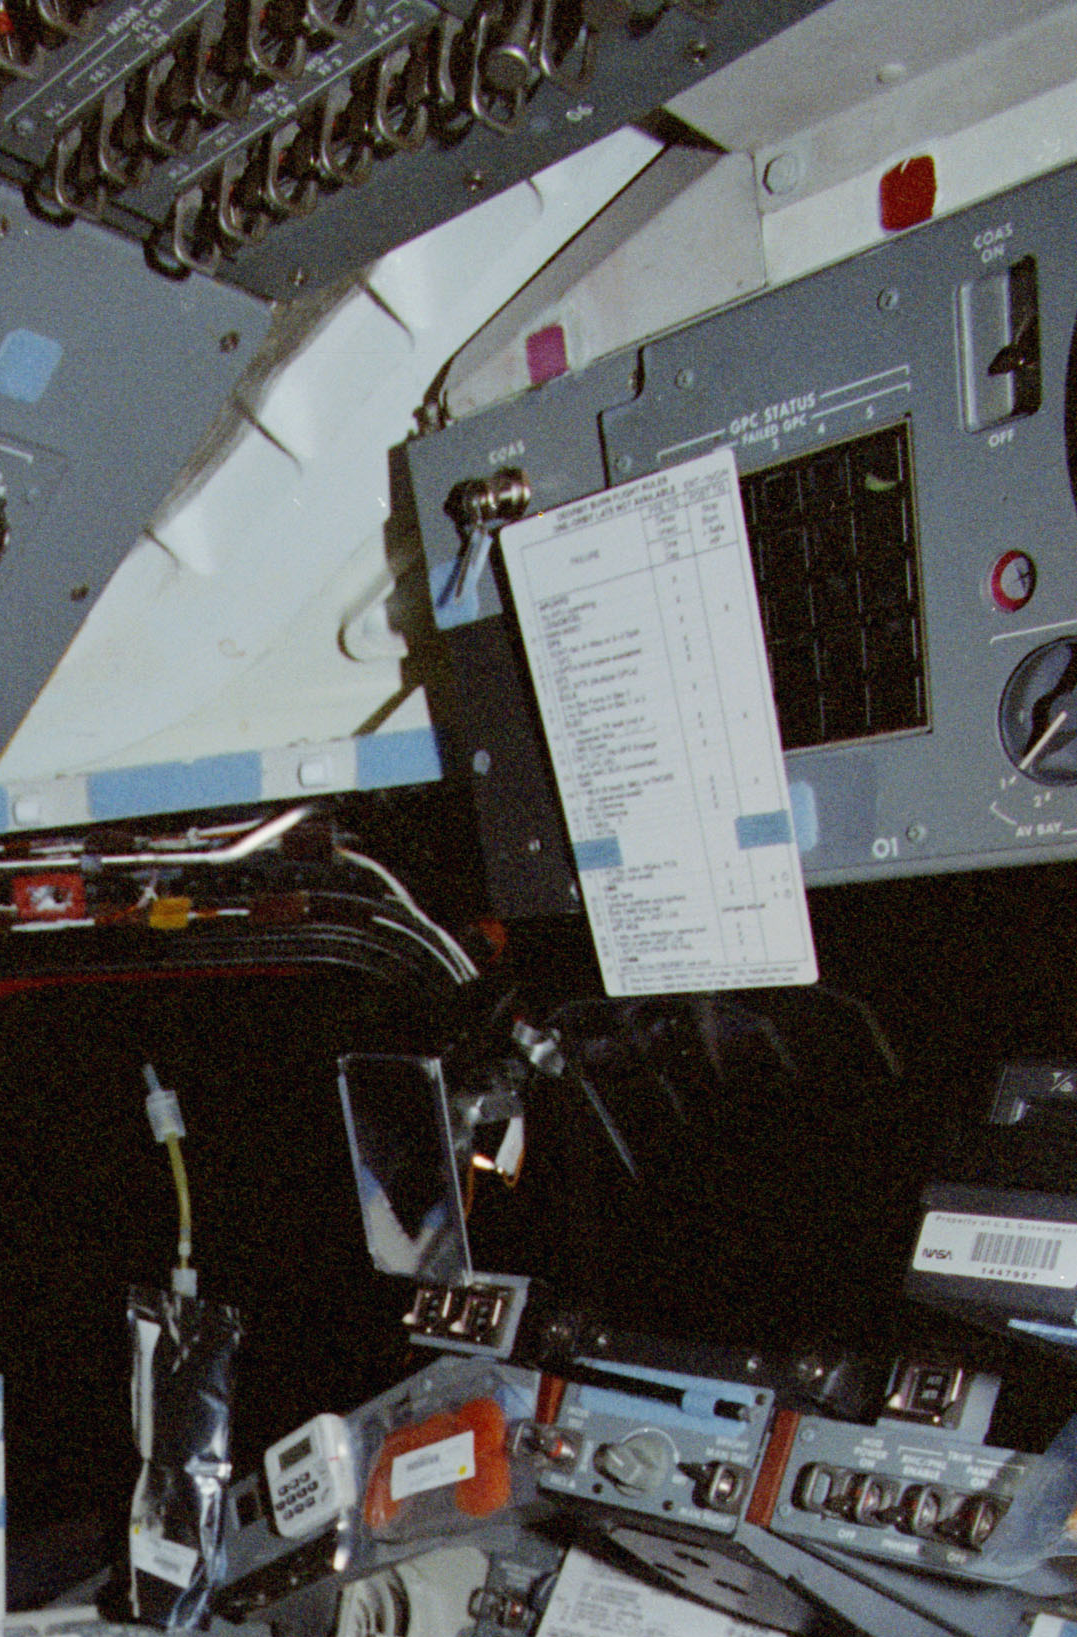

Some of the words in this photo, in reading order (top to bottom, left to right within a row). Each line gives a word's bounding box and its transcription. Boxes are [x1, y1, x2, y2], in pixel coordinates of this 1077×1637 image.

[973, 222, 1013, 250] COAS
[981, 244, 1004, 264] ON
[729, 412, 759, 436] GPC
[764, 392, 817, 424] STATUS
[741, 423, 780, 446] FAILED
[782, 413, 807, 433] GPC
[988, 429, 1015, 448] OFF
[1015, 824, 1033, 838] AV
[1036, 821, 1063, 837] BAY
[922, 1247, 951, 1259] NASA
[854, 1447, 886, 1459] POWER
[948, 1451, 971, 1462] TRIM
[859, 1459, 874, 1467] ON
[902, 1466, 939, 1479] ENABLE
[837, 1529, 855, 1540] OFF
[946, 1552, 965, 1563] OFF
